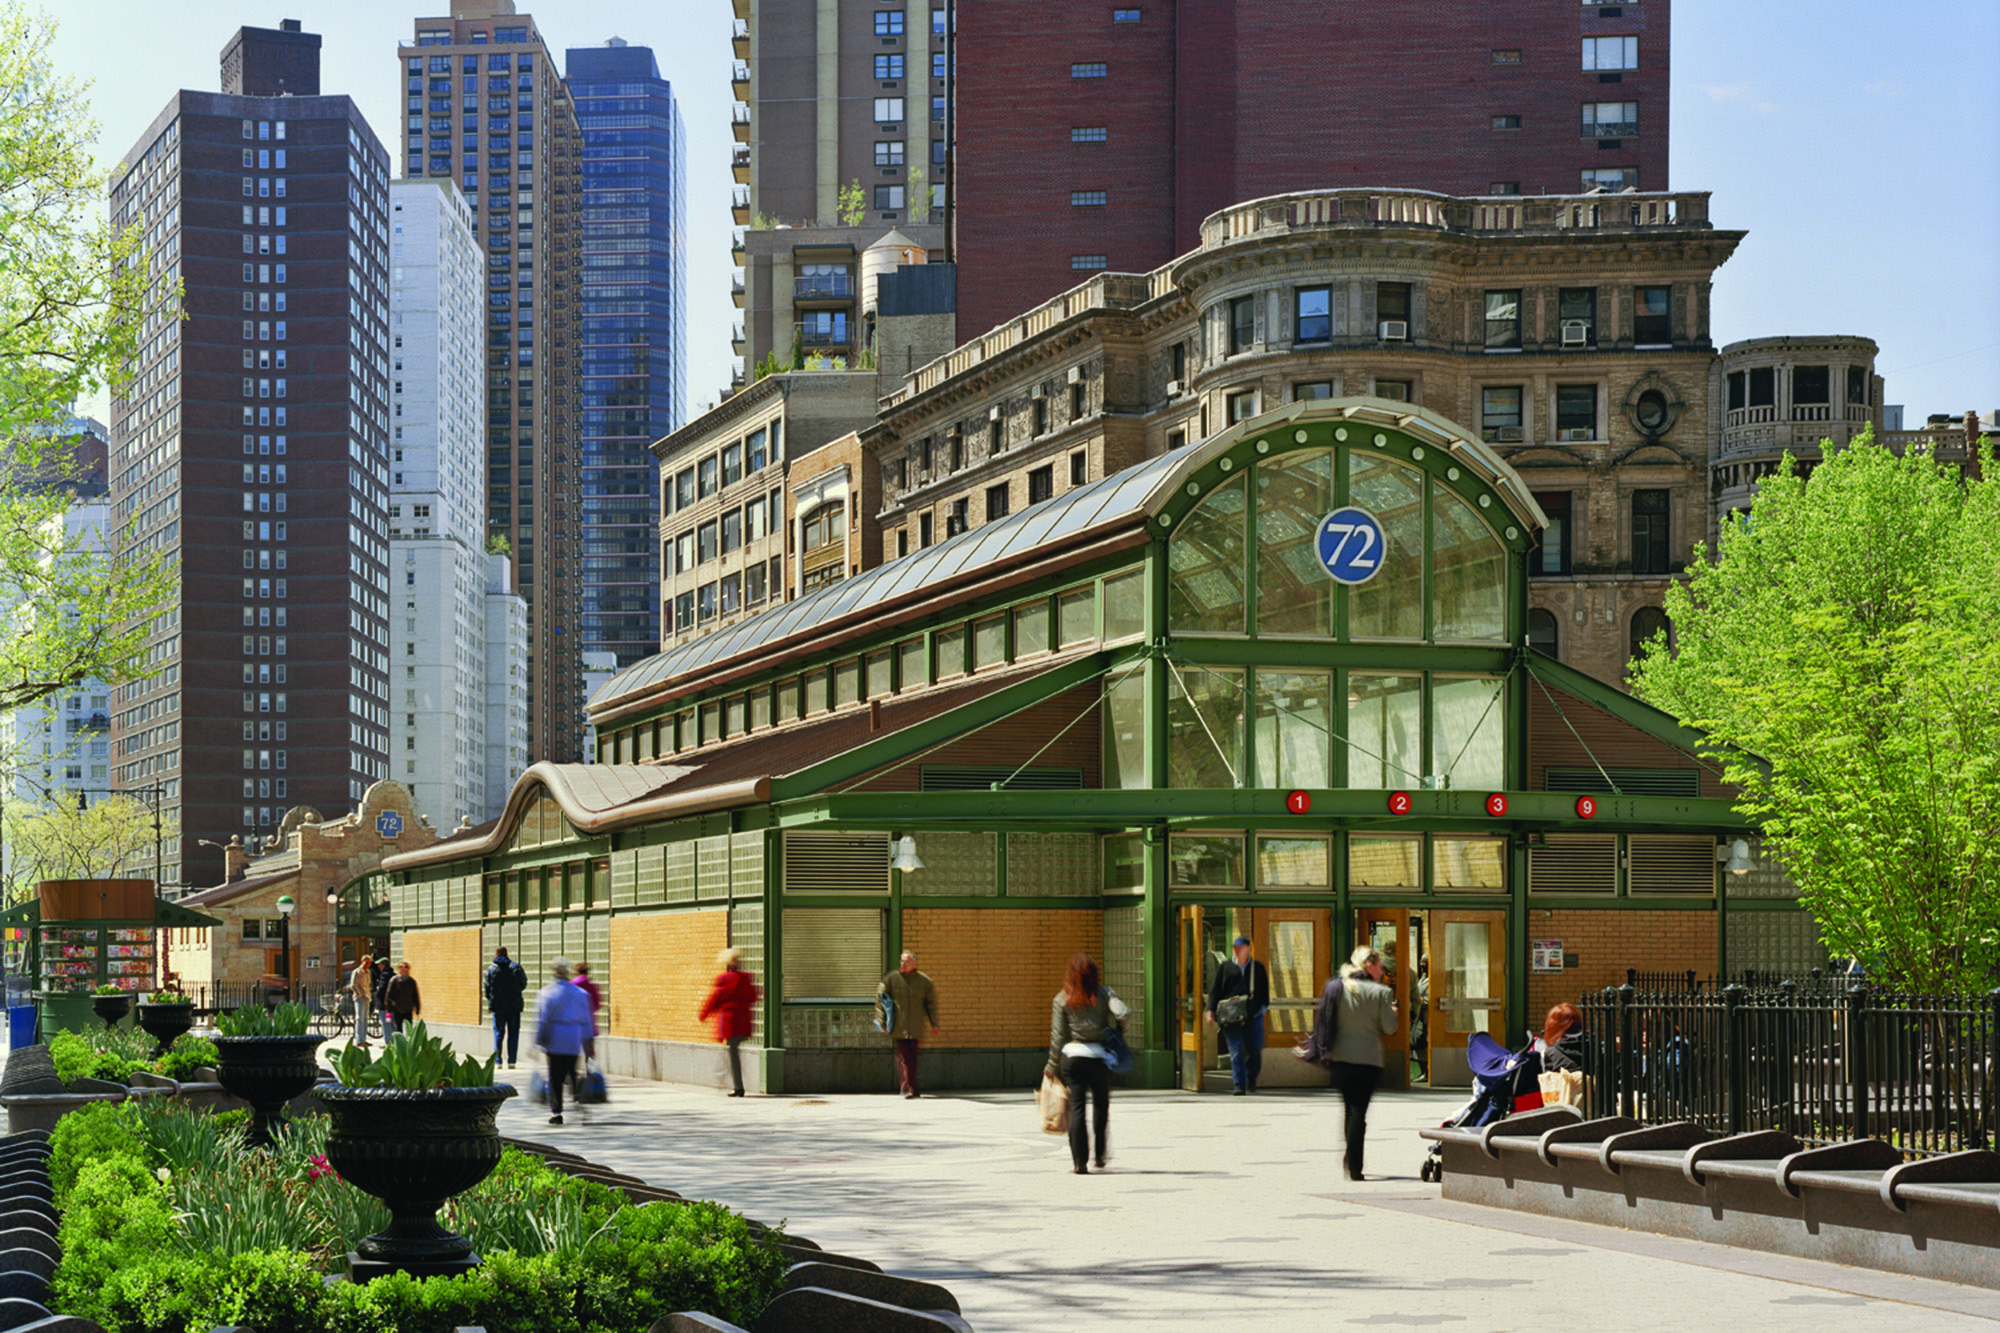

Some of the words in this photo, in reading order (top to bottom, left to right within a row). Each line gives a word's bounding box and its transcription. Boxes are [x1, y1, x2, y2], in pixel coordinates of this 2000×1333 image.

[1326, 523, 1375, 568] 72
[1295, 795, 1302, 809] 1
[1396, 796, 1406, 810] 2
[1493, 798, 1503, 812] 3
[1583, 800, 1592, 814] 9
[381, 817, 398, 830] 72
